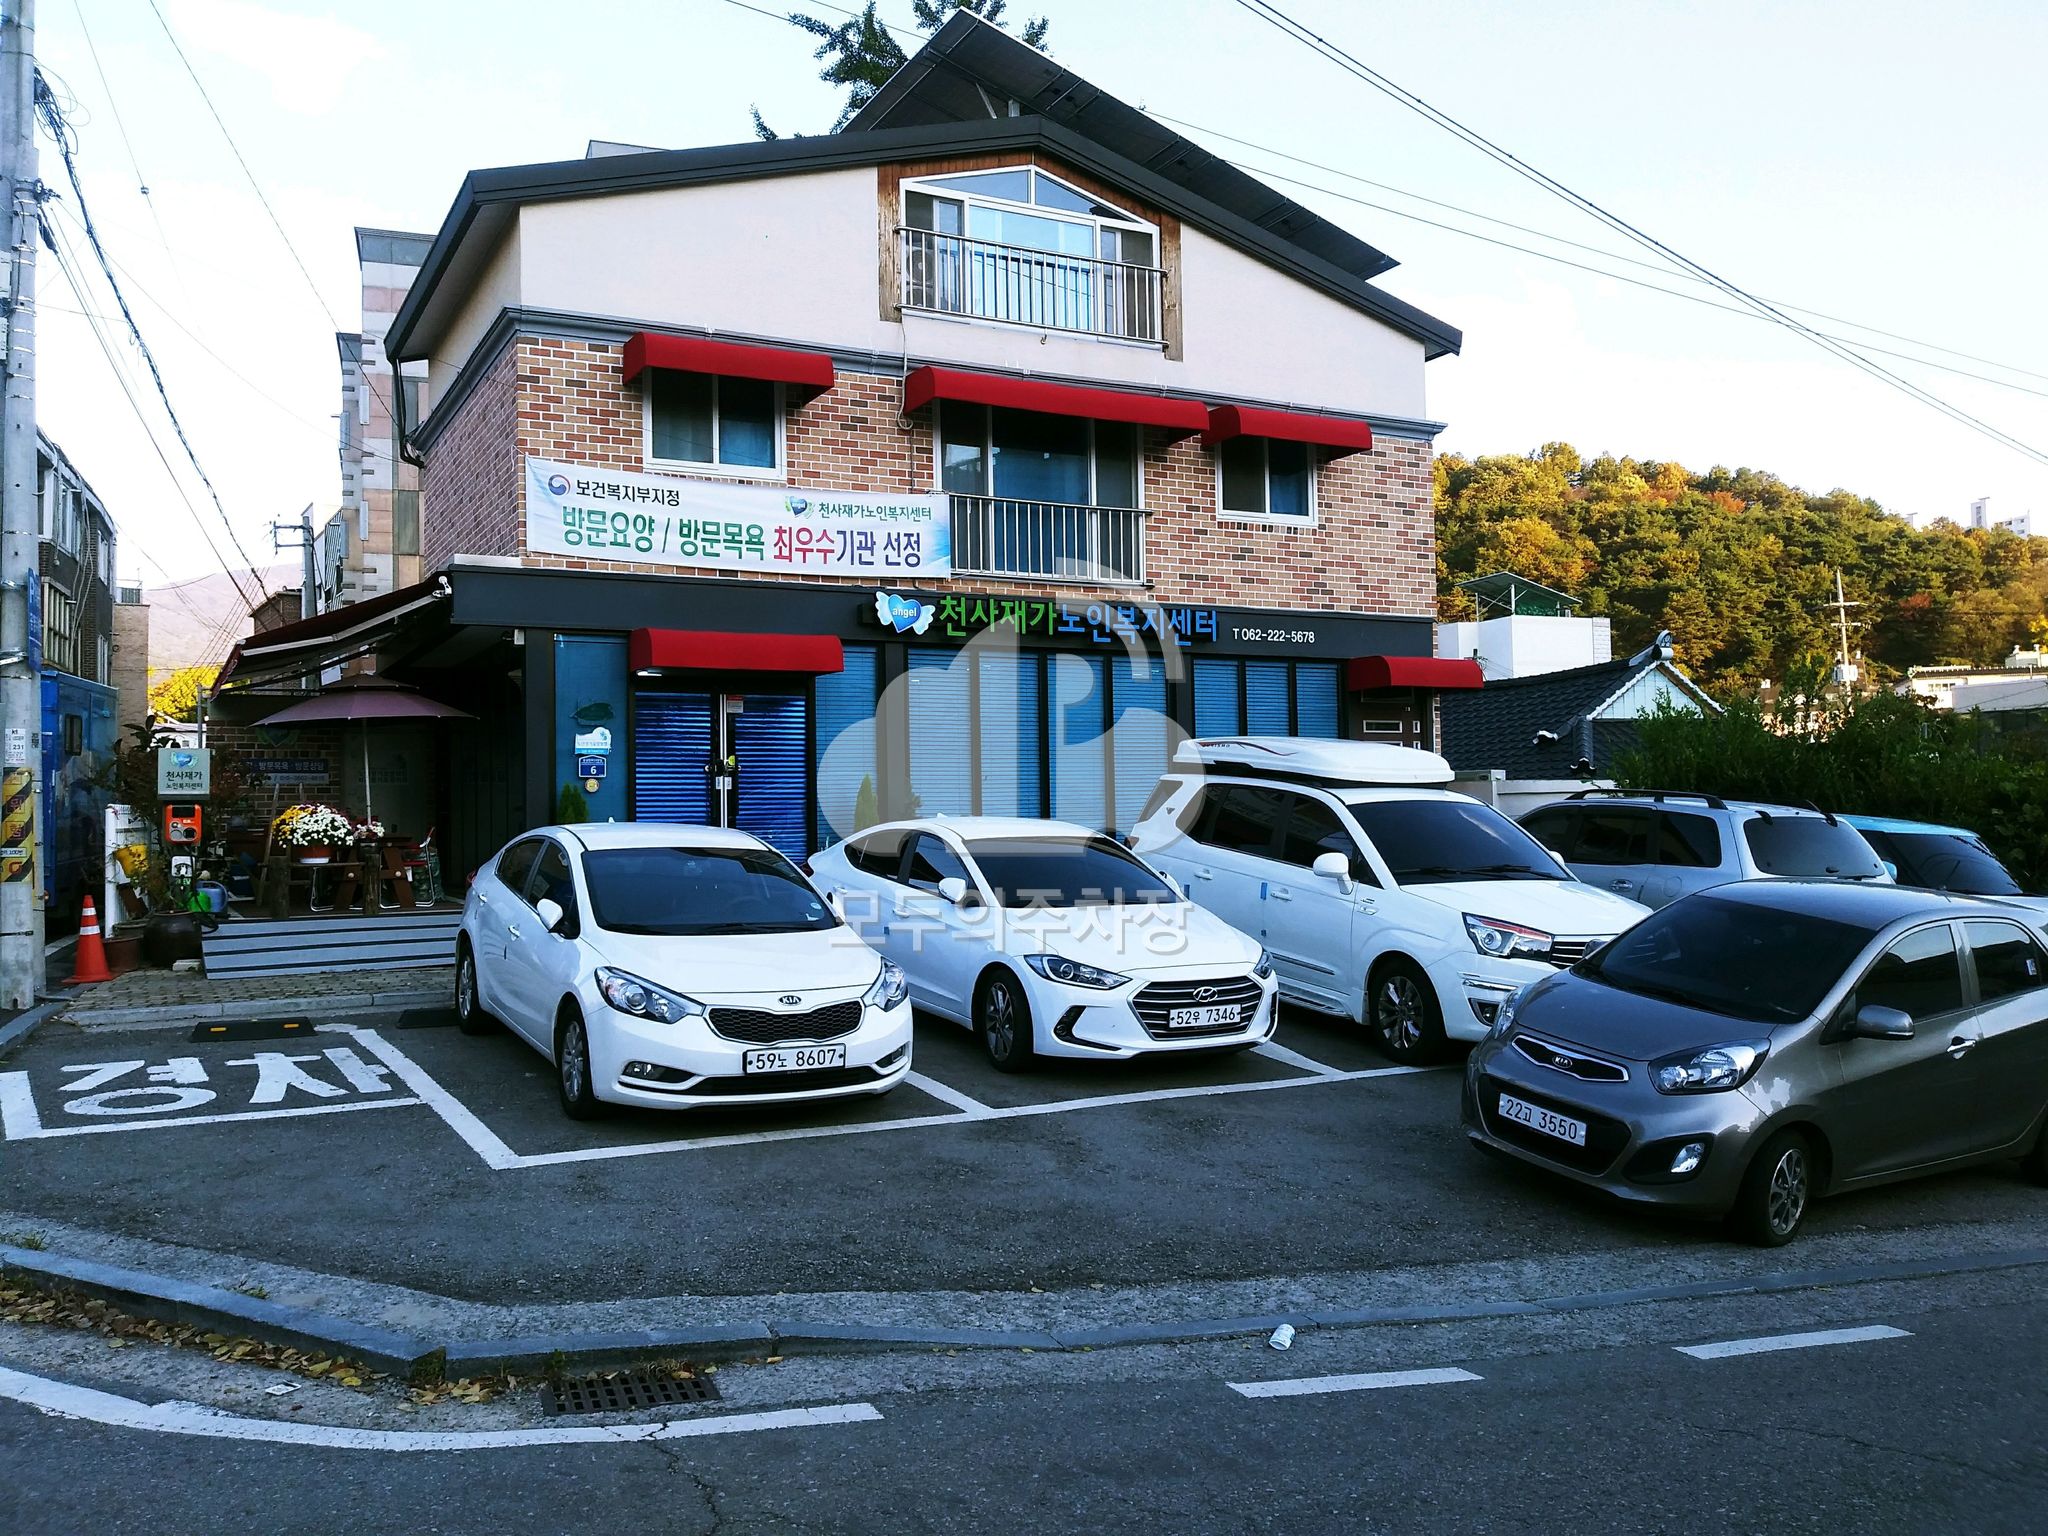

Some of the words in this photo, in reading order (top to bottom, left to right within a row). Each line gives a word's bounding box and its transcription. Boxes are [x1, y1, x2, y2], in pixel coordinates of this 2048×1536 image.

[576, 479, 680, 506] 보건복지부지정
[819, 502, 932, 522] 천사재가노인복지센터
[562, 505, 655, 553] 방문요양
[679, 518, 765, 561] 방문목욕
[773, 525, 876, 566] 최우수기관
[883, 531, 921, 567] 선정
[892, 607, 917, 618] angel
[1241, 628, 1315, 643] 062-222-5678
[166, 771, 202, 782] 천사재가
[590, 766, 597, 775] 6
[1176, 1010, 1201, 1025] 52우
[1206, 1006, 1236, 1022] 7346
[756, 1053, 787, 1070] 59노
[796, 1048, 836, 1067] 8607
[60, 1047, 392, 1115] 경차
[1505, 1099, 1532, 1123] 22고
[1538, 1111, 1578, 1140] 3550
